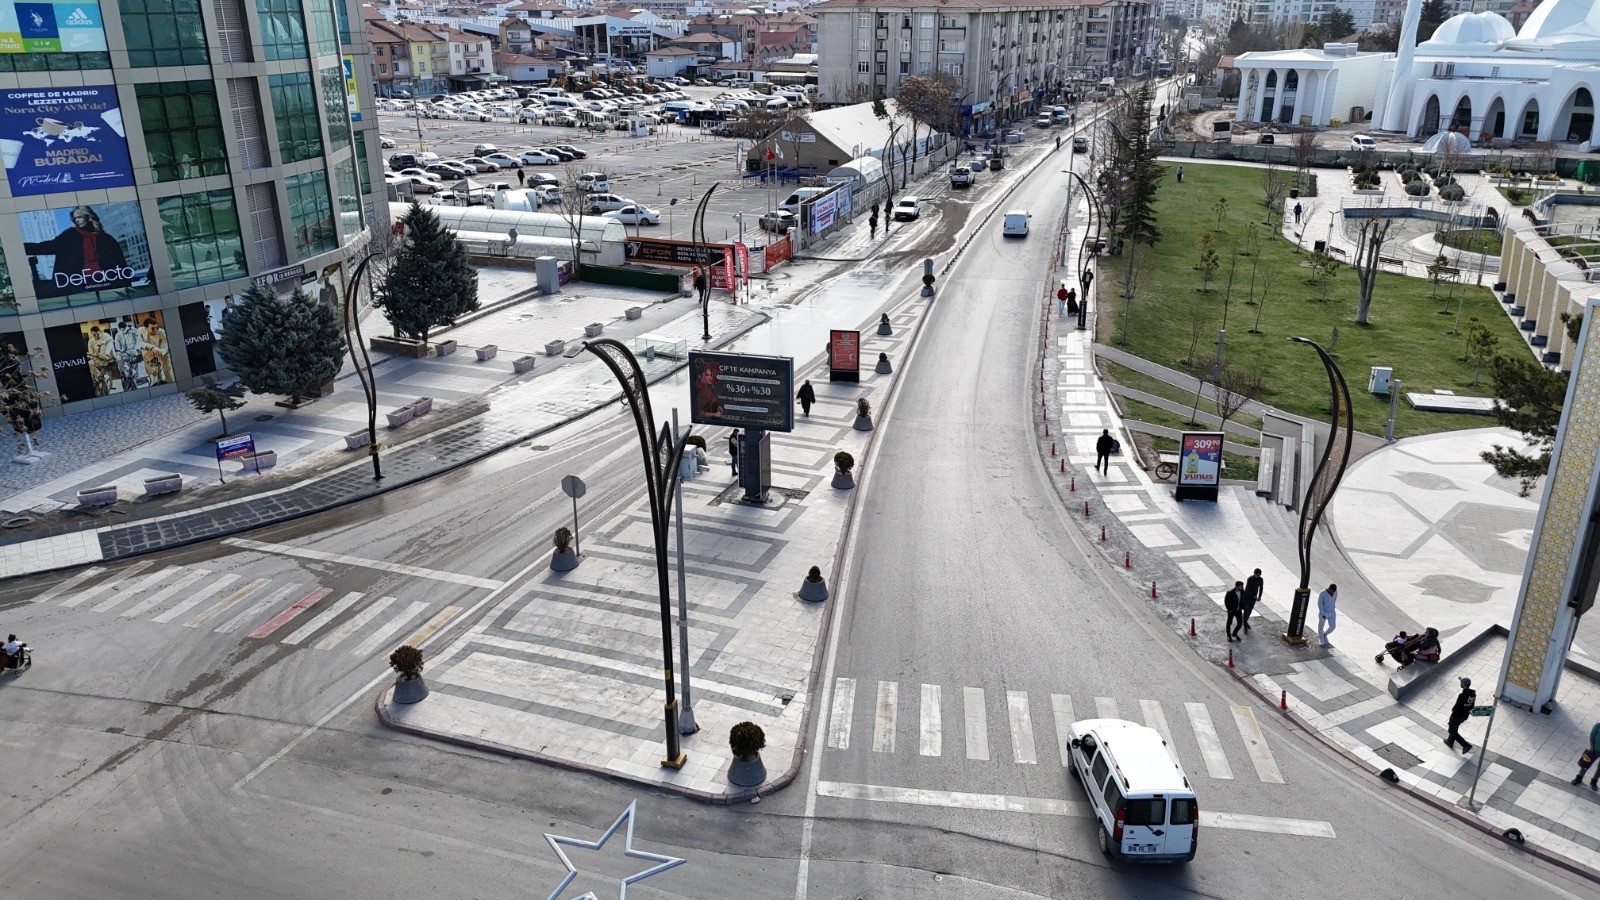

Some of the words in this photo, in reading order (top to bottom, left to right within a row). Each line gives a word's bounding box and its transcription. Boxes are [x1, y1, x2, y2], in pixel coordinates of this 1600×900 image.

[37, 105, 60, 113] City
[34, 154, 103, 166] BURADA!
[54, 265, 135, 288] DeFacto
[739, 367, 777, 376] KAMPANYA
[726, 383, 771, 396] %30+%30
